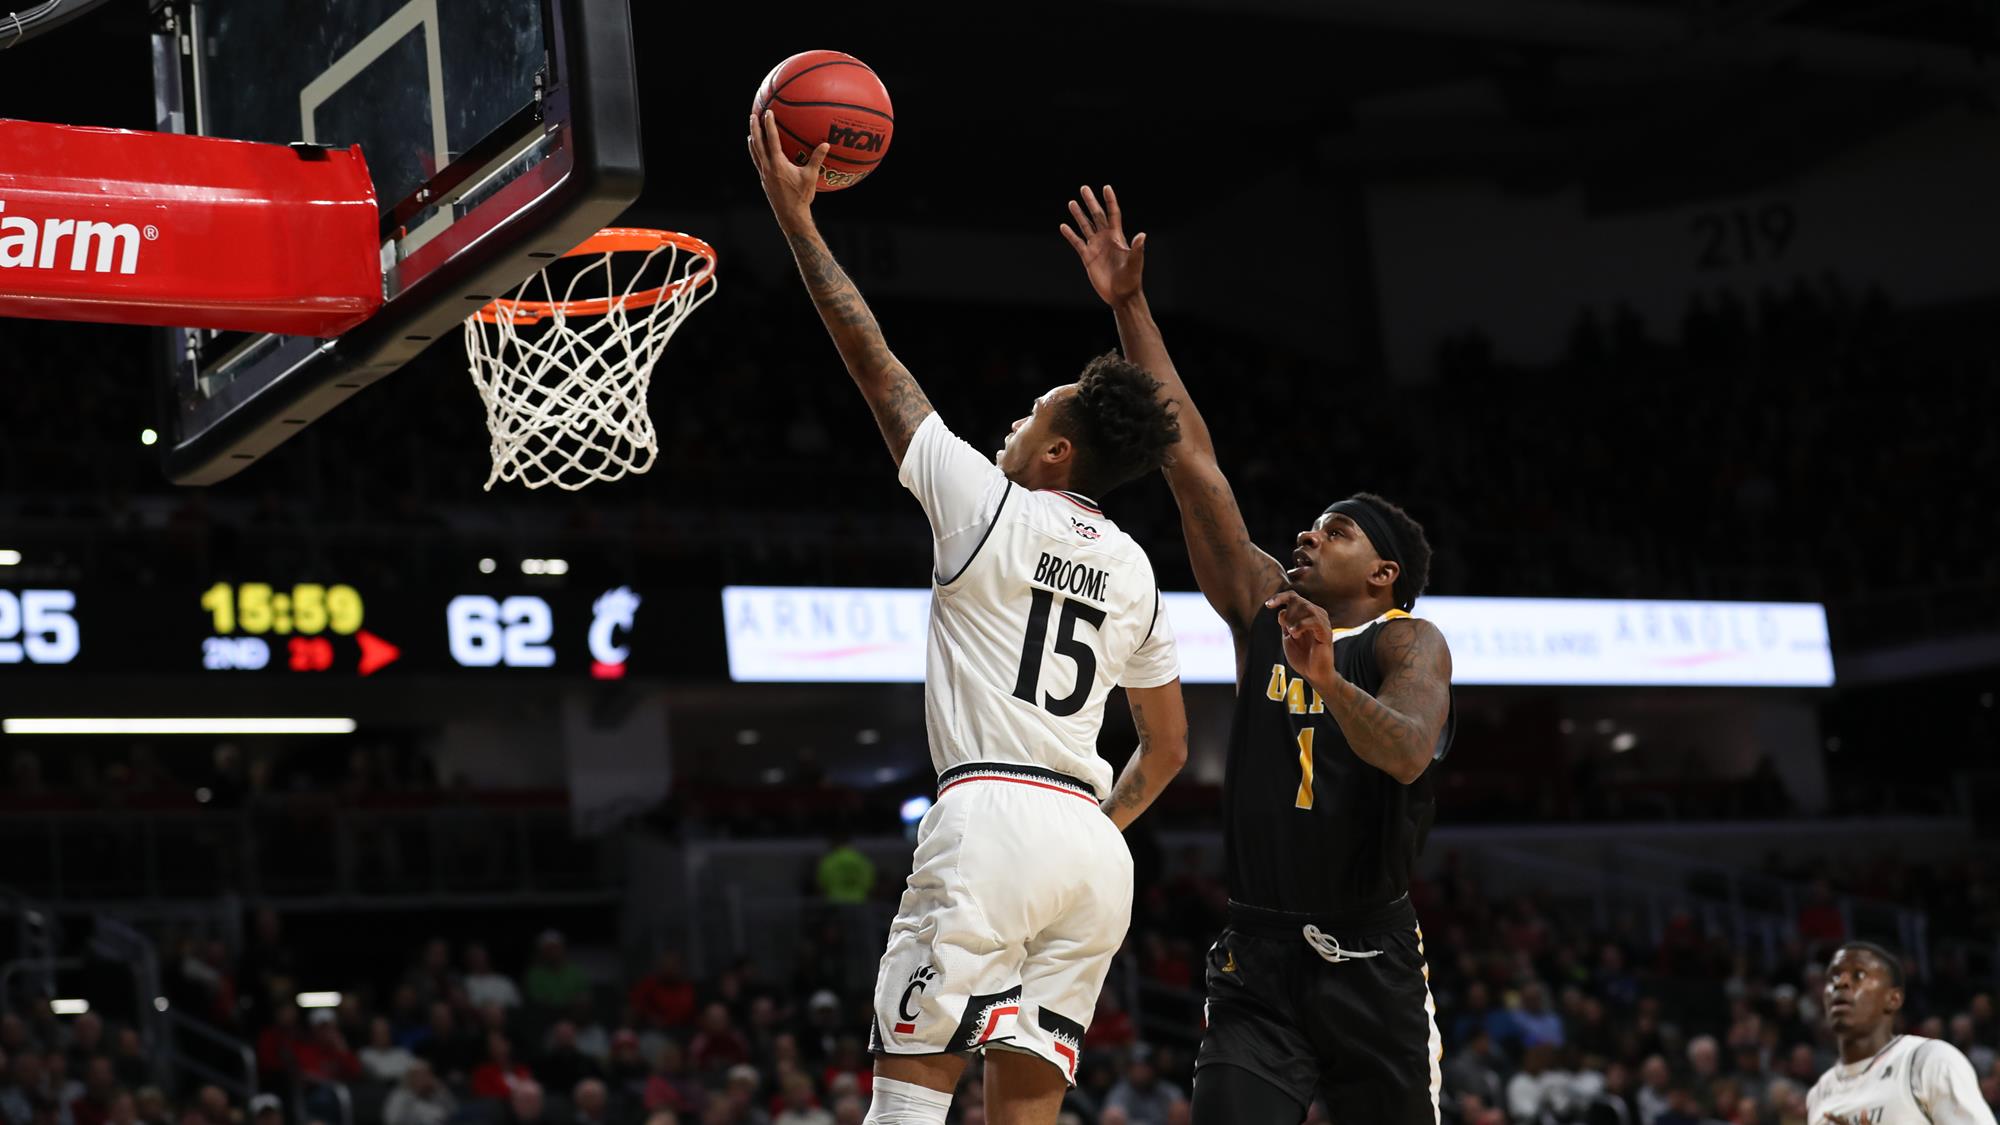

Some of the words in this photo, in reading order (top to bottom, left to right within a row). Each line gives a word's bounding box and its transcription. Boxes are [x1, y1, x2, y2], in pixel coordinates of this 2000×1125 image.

[828, 123, 886, 153] NCAA
[0, 199, 141, 275] arm
[1688, 203, 1797, 271] 219
[201, 582, 364, 635] 15:59
[1033, 552, 1110, 602] BROOME
[202, 637, 270, 670] 2ND
[446, 595, 556, 667] 62
[1012, 587, 1108, 717] 15
[1295, 727, 1315, 810] 1
